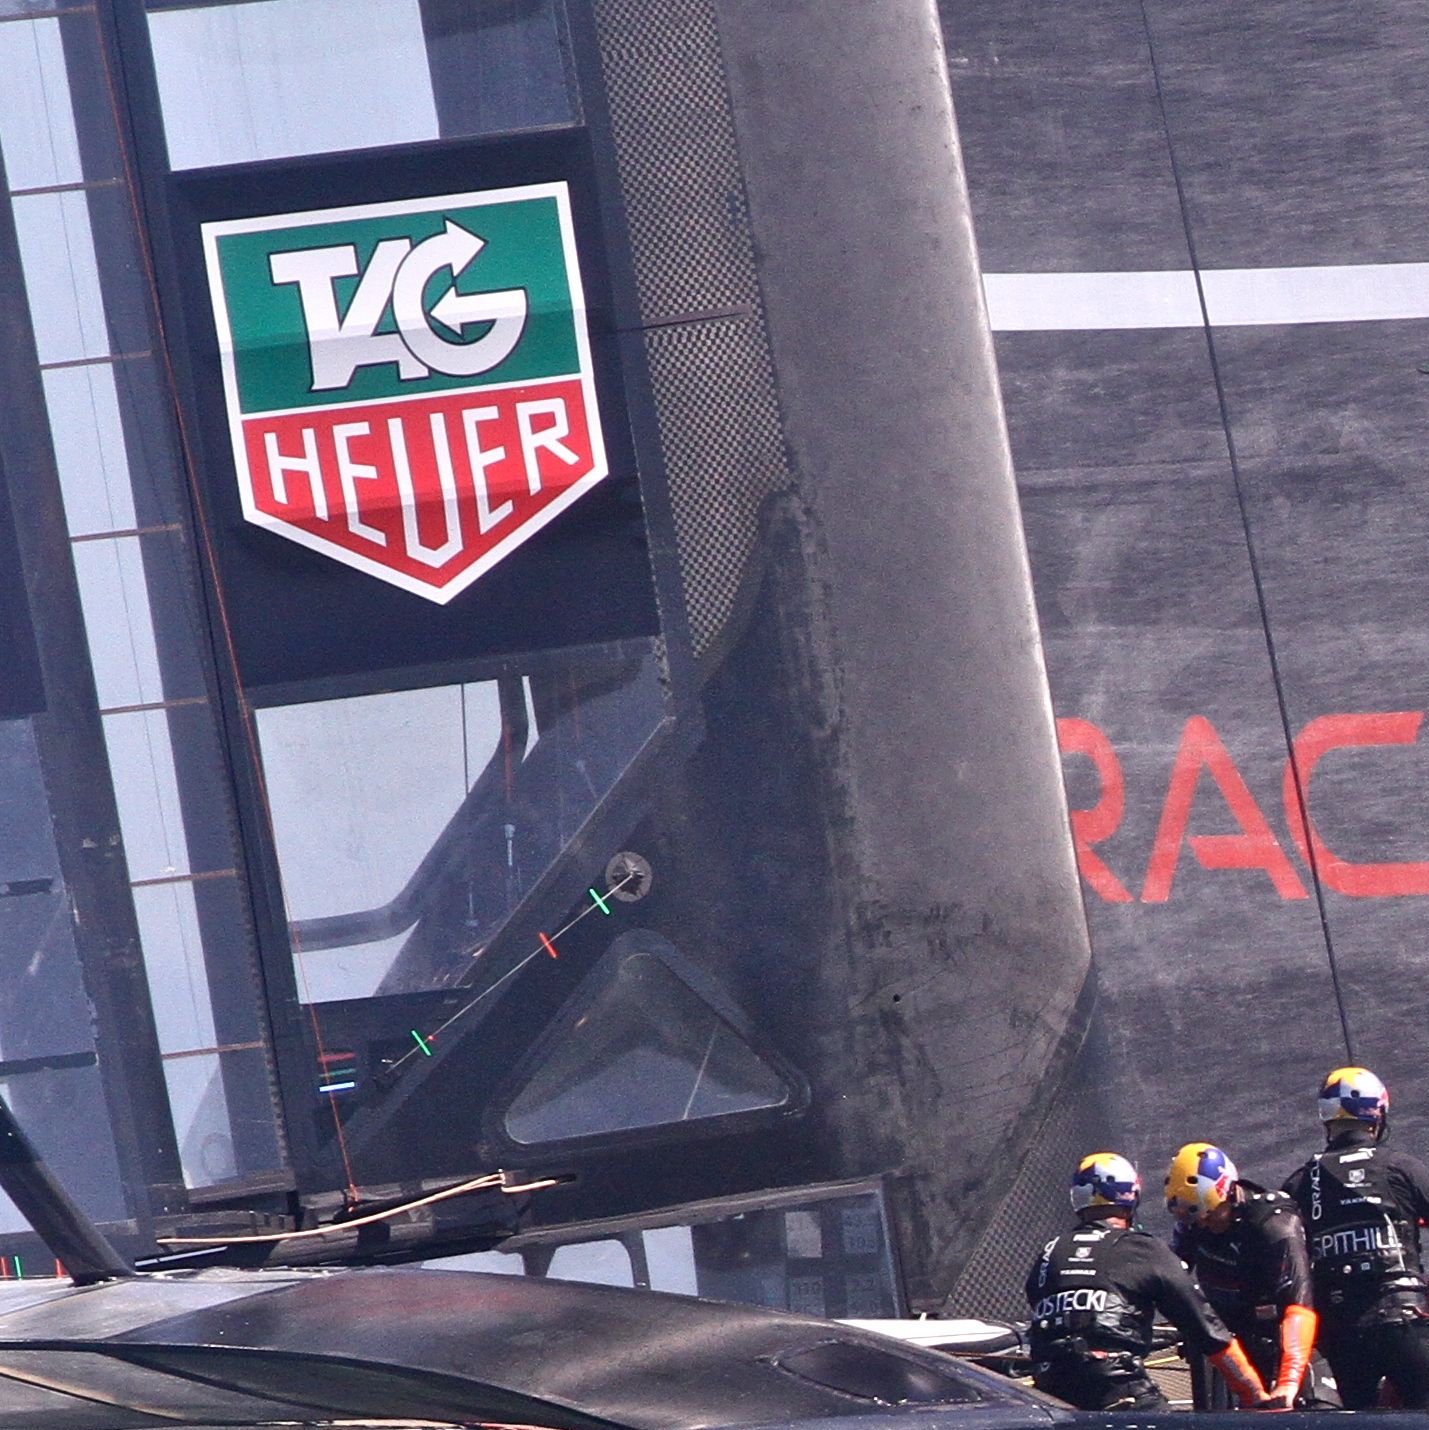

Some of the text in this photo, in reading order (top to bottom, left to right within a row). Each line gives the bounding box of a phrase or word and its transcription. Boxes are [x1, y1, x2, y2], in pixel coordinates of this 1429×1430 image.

[269, 216, 527, 391] TAG
[264, 397, 580, 569] HEUER
[1034, 1289, 1108, 1319] OSTECKI
